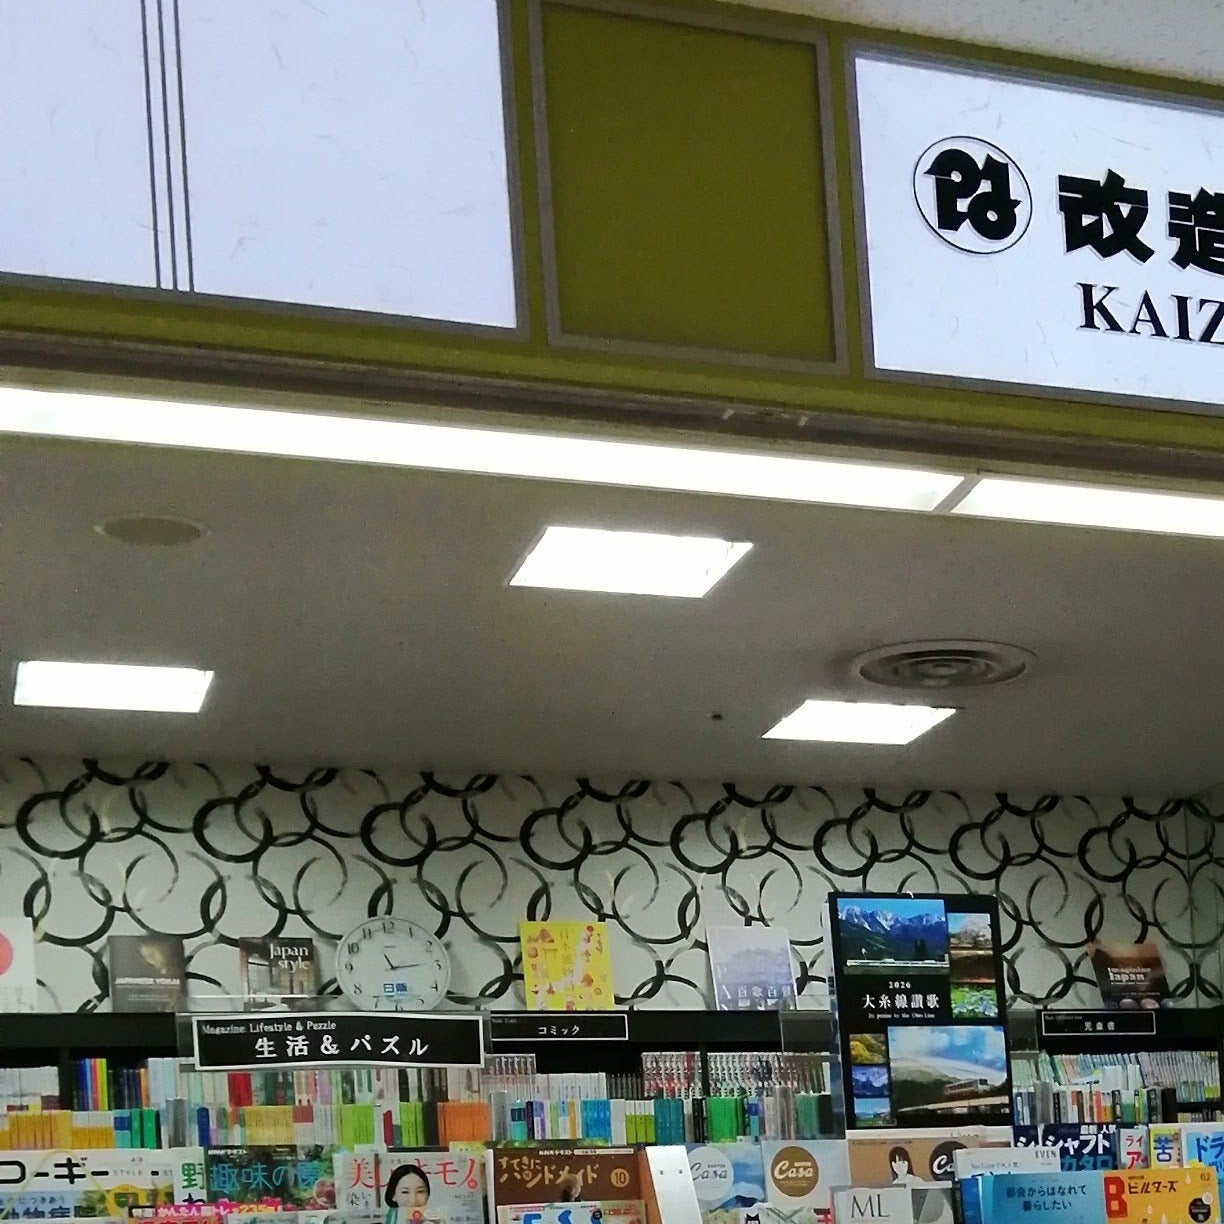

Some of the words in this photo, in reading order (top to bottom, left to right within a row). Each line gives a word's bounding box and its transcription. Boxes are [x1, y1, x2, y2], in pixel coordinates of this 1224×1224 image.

[382, 921, 394, 934] 12
[269, 943, 309, 960] Japan
[347, 943, 360, 955] 10
[278, 958, 310, 973] style
[888, 981, 912, 989] 2026
[1109, 973, 1145, 983] Japan
[1035, 1150, 1057, 1159] EVEN
[1153, 1136, 1173, 1163] 苦
[498, 1155, 542, 1171] すてきに
[773, 1160, 814, 1180] Casa
[614, 1172, 625, 1185] 10
[1104, 1176, 1128, 1218] B
[851, 1195, 890, 1219] ML
